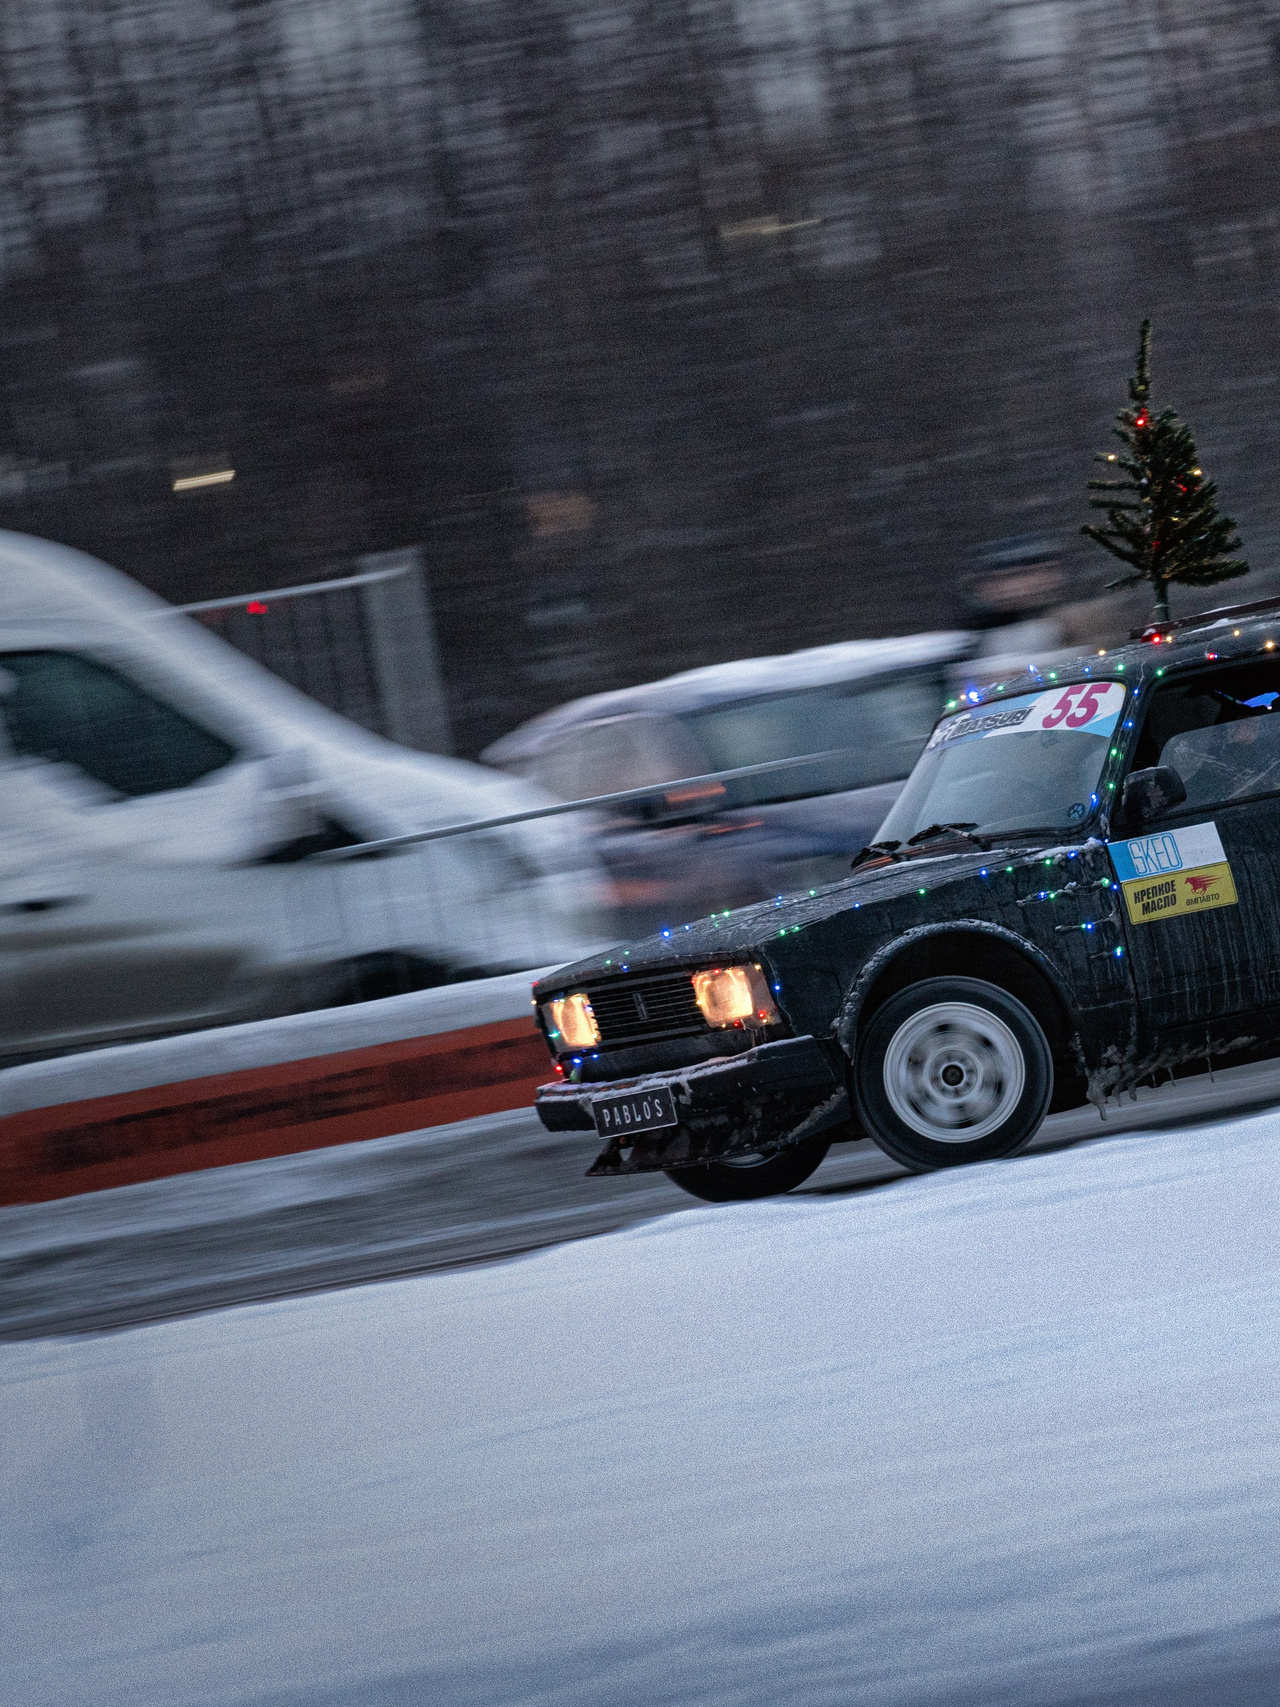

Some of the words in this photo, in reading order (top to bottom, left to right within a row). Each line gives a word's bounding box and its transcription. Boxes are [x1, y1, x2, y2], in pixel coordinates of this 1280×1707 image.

[1041, 682, 1112, 729] 55
[1133, 880, 1176, 904] КРЕПКОЕ
[1141, 893, 1177, 915] МАСЛО
[1185, 893, 1220, 906] ВМПАВТО
[602, 1096, 663, 1127] PABLO'S
